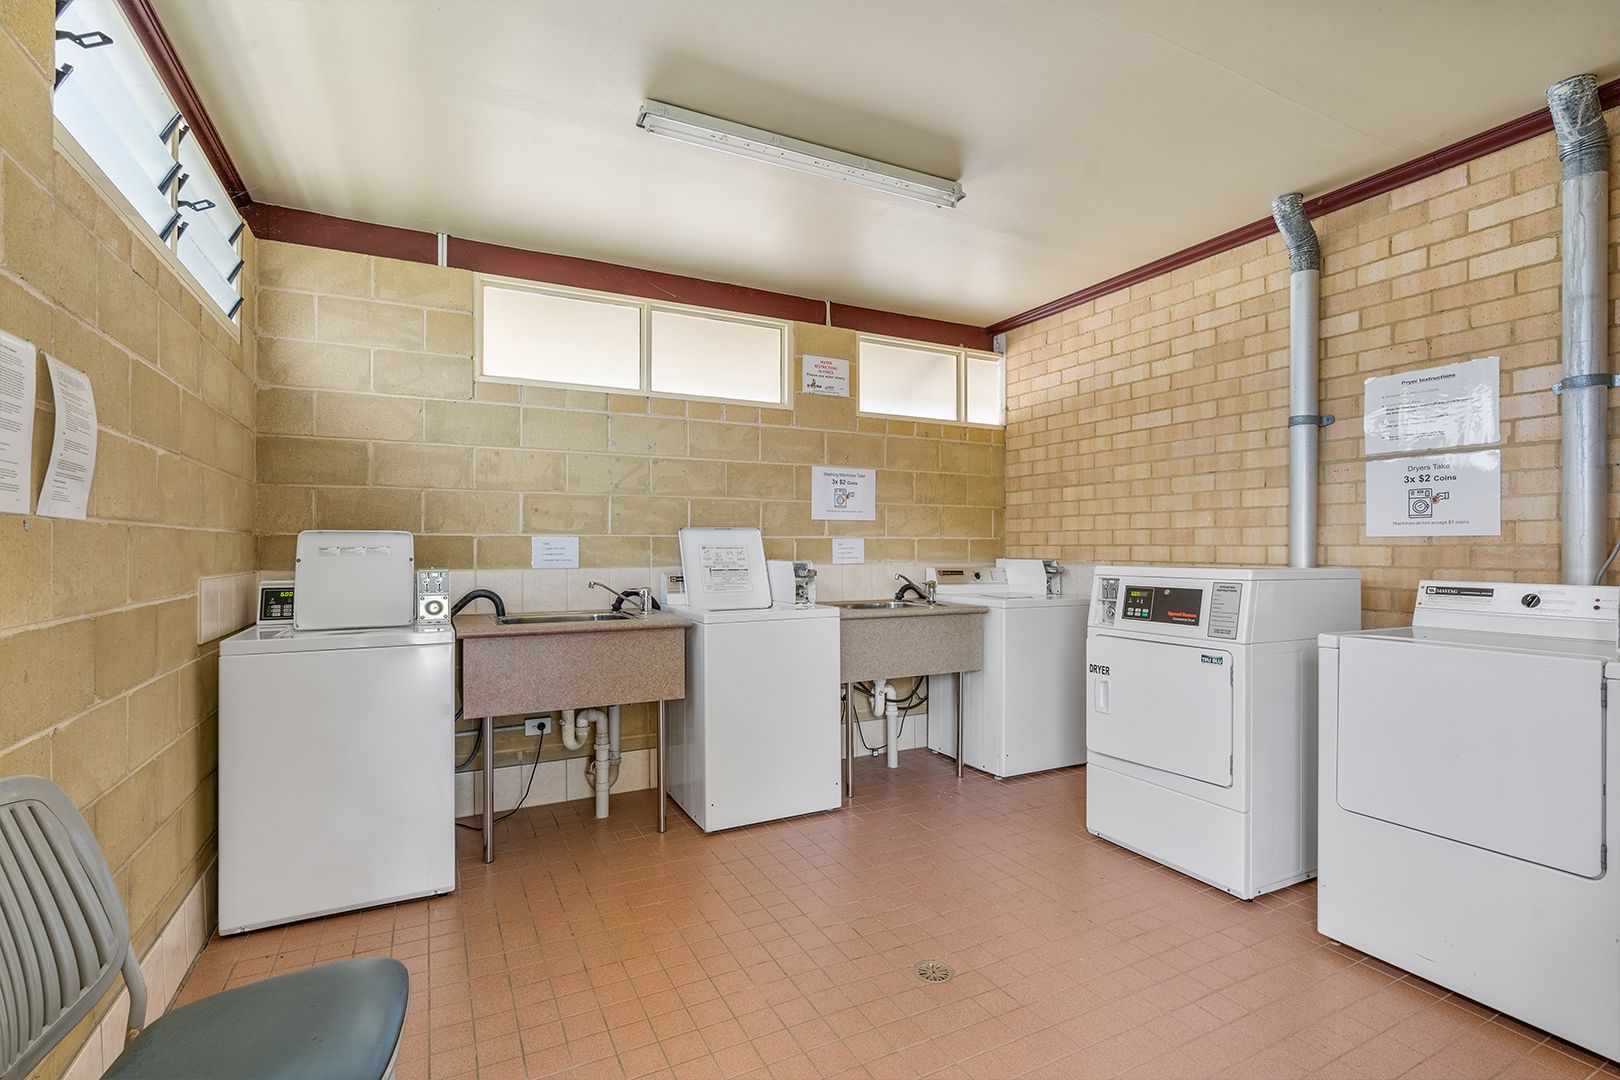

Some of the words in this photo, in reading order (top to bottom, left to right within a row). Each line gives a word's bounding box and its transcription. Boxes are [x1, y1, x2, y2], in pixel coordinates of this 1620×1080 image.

[1418, 373, 1456, 383] Instructions
[1408, 465, 1431, 473] Dryers
[1403, 475, 1416, 484] 3x
[1418, 474, 1431, 484] $2
[1089, 663, 1110, 676] DRYER
